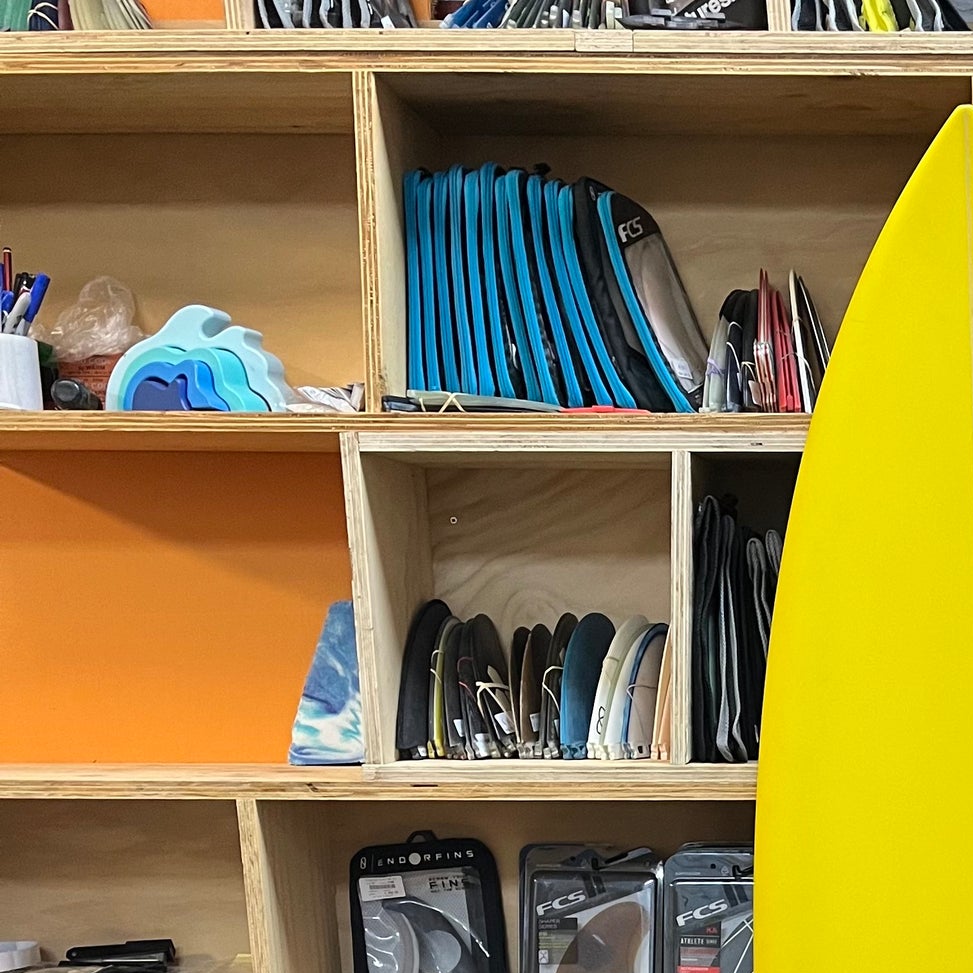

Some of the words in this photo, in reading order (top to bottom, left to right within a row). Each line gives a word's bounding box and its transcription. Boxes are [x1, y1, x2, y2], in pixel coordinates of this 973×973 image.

[618, 216, 643, 243] FCS
[536, 889, 586, 916] FCS
[676, 899, 728, 927] FCS
